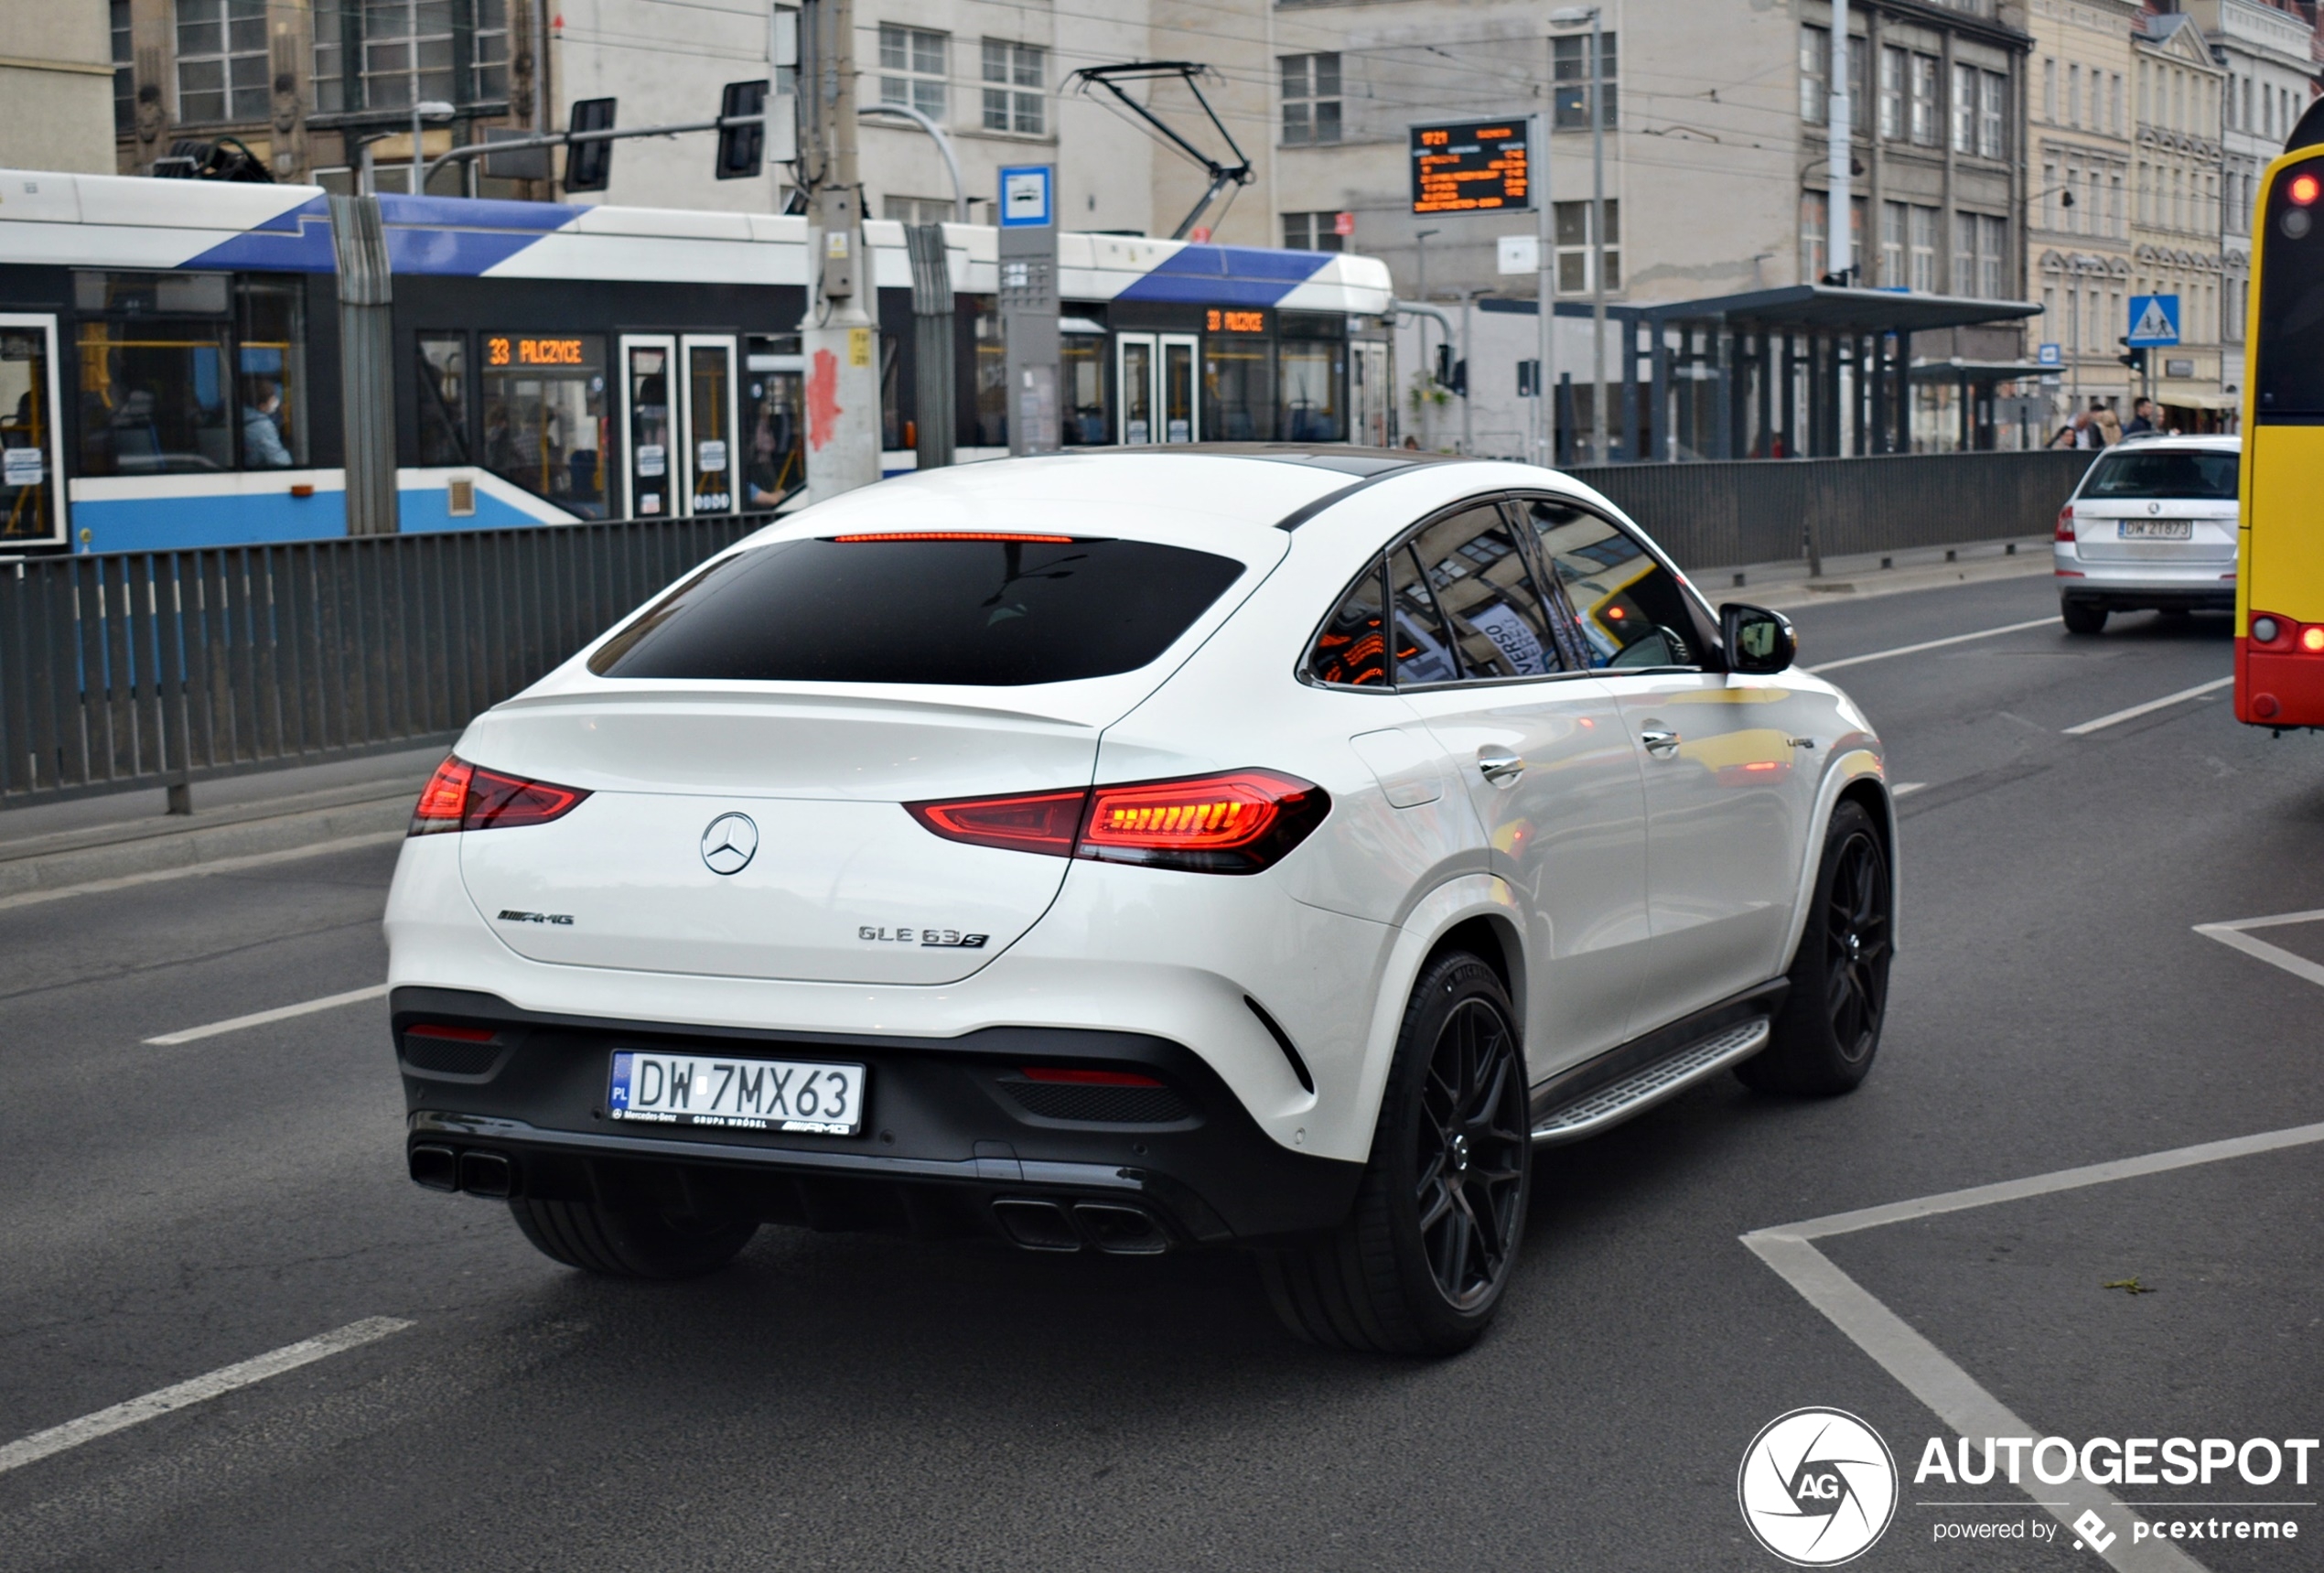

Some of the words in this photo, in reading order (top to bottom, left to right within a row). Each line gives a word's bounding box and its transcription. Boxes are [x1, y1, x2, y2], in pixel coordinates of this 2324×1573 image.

[488, 338, 510, 364] 33
[519, 339, 582, 363] PILCZYCE
[2126, 520, 2145, 534] DW
[521, 910, 574, 925] AMG
[858, 925, 914, 942] GLE
[613, 1086, 628, 1100] PL
[639, 1059, 694, 1109] DW
[710, 1062, 849, 1118] 7MX63
[624, 1110, 677, 1123] Mercedes-Benz
[693, 1115, 725, 1126] GRUPA
[728, 1117, 768, 1129] WRÓBEL
